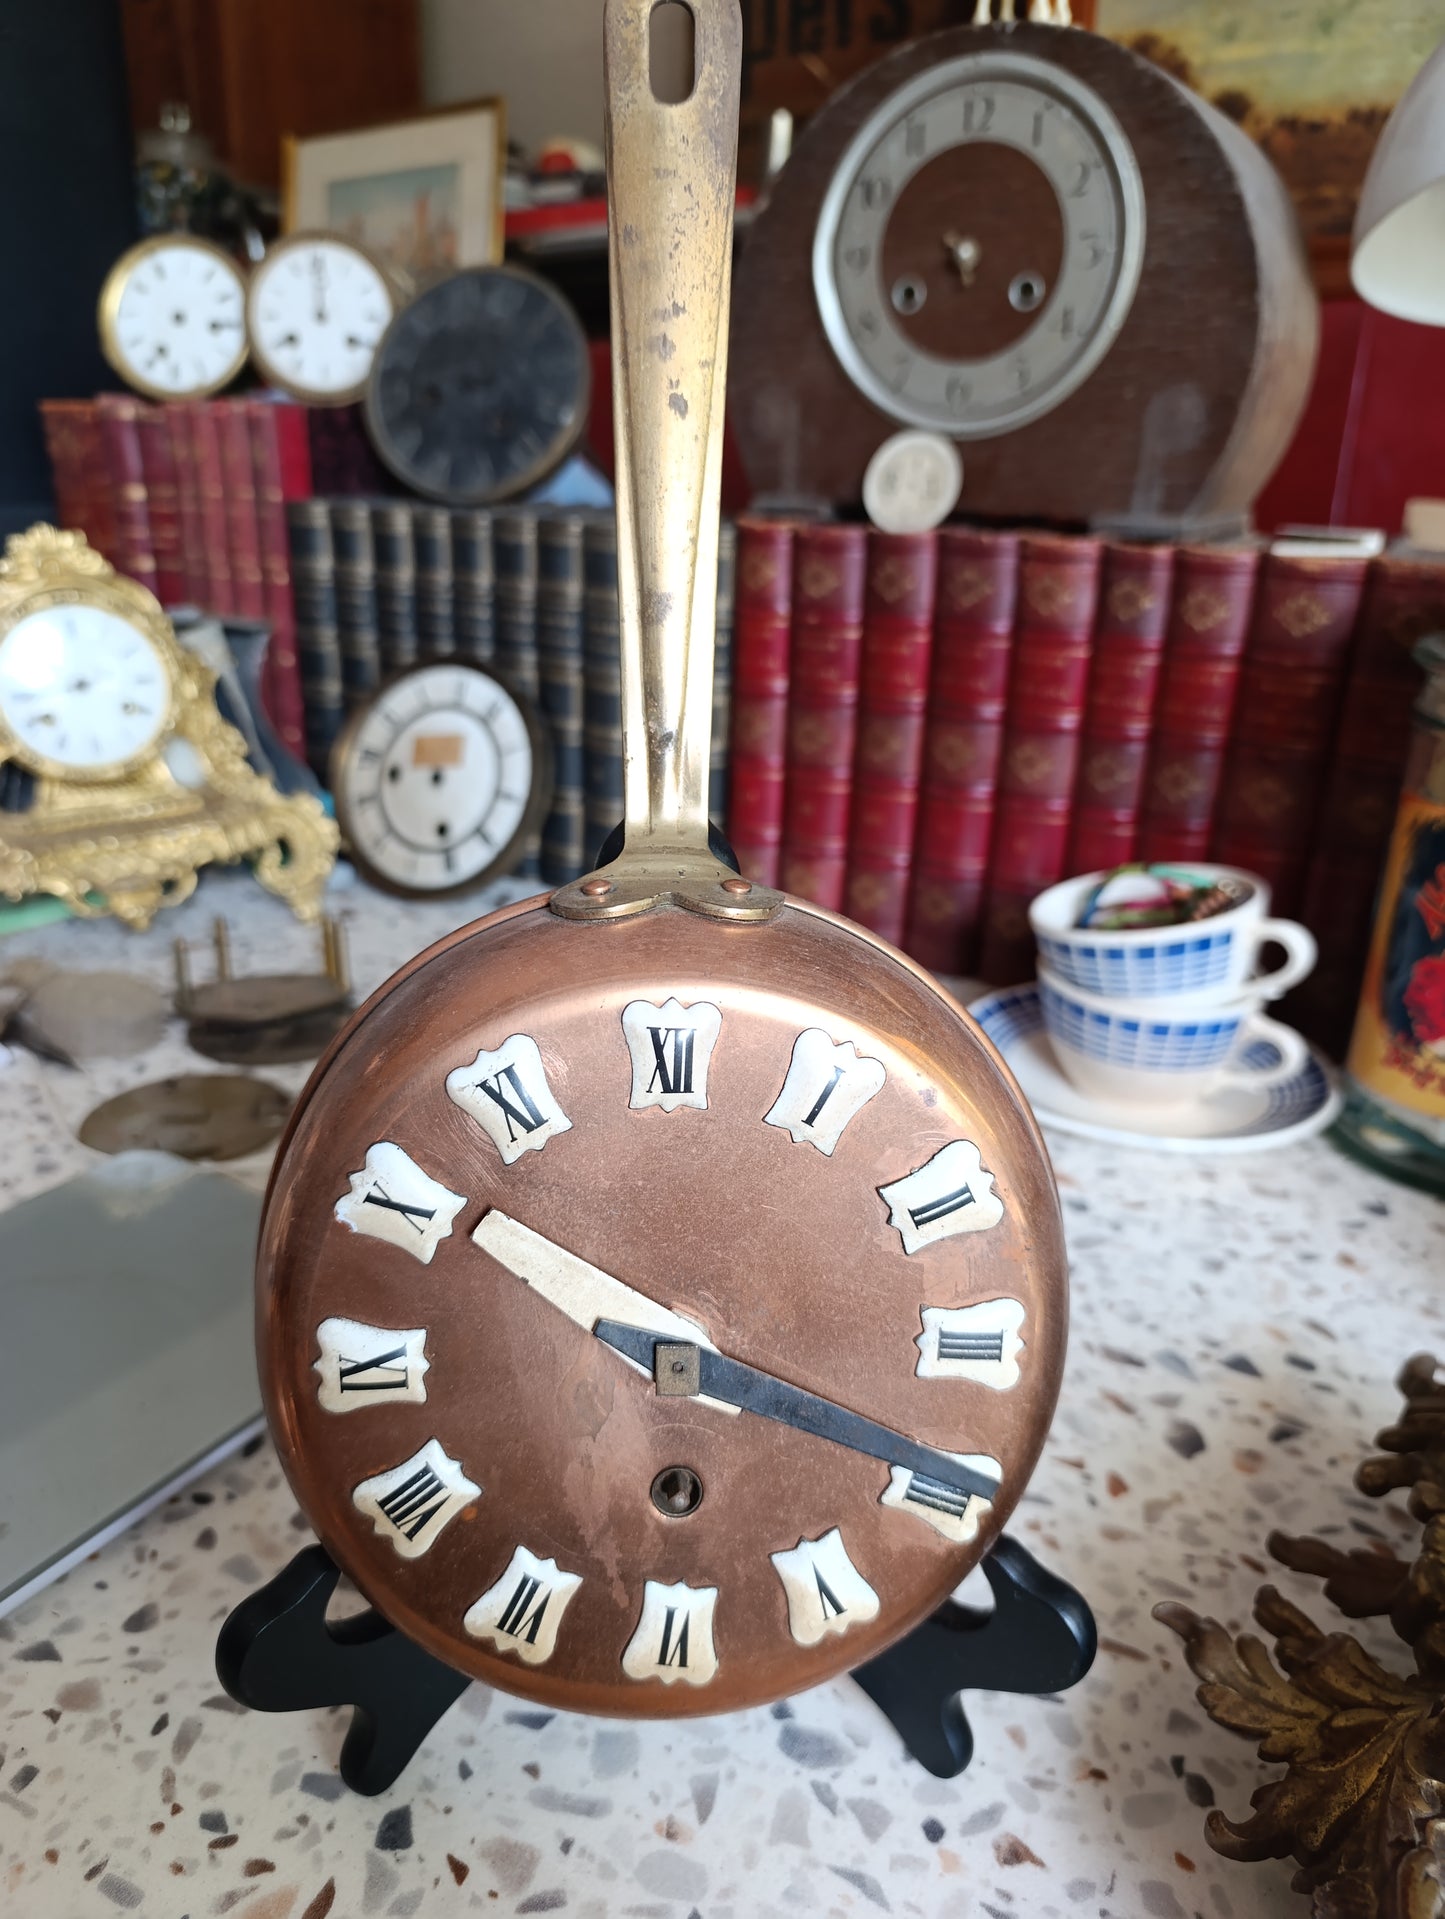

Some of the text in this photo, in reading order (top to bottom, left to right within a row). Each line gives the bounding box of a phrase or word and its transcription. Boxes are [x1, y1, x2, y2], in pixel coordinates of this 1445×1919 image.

[962, 95, 996, 133] 12
[1031, 110, 1044, 149] 1
[1066, 161, 1091, 198] 2
[646, 1026, 697, 1094] XII
[475, 1063, 549, 1143] XI
[800, 1065, 846, 1128] I
[362, 1180, 437, 1235] X
[908, 1182, 976, 1230] II
[338, 1342, 409, 1394] IX
[937, 1327, 1004, 1362] III
[375, 1461, 453, 1542] VIII
[496, 1571, 553, 1645] VII
[810, 1560, 848, 1621] V
[655, 1604, 691, 1668] VI
